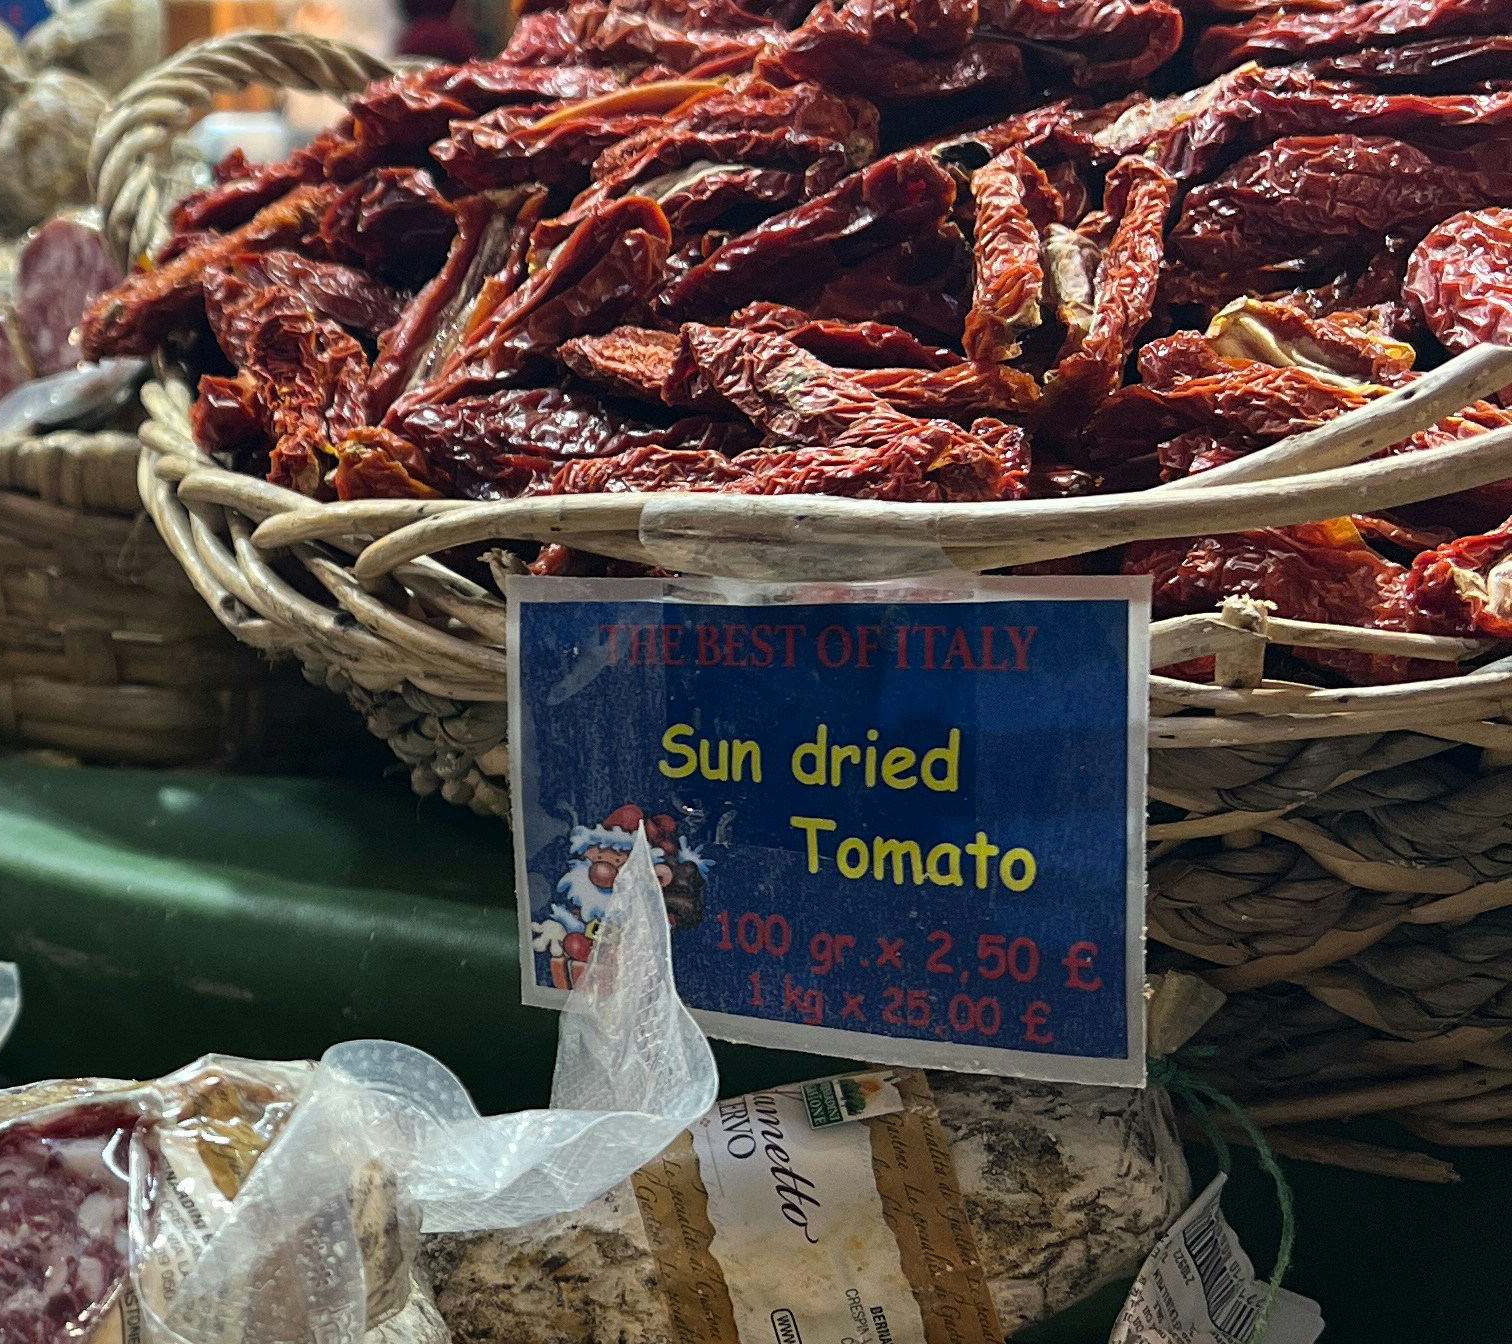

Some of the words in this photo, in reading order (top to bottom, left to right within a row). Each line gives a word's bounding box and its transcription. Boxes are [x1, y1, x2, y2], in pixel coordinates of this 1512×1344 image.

[600, 623, 686, 666] THE
[697, 625, 807, 668] BEST
[816, 625, 881, 669] OF
[894, 626, 1037, 672] ITALY
[658, 723, 762, 783] Sun
[791, 723, 960, 792] dried
[790, 816, 1036, 892] Tomato
[717, 910, 789, 956] 100
[927, 930, 1039, 983] 2,50
[1063, 941, 1102, 992] £
[749, 971, 764, 1006] 1
[784, 974, 825, 1027] kg
[841, 993, 866, 1022] x
[1021, 1001, 1054, 1045] £
